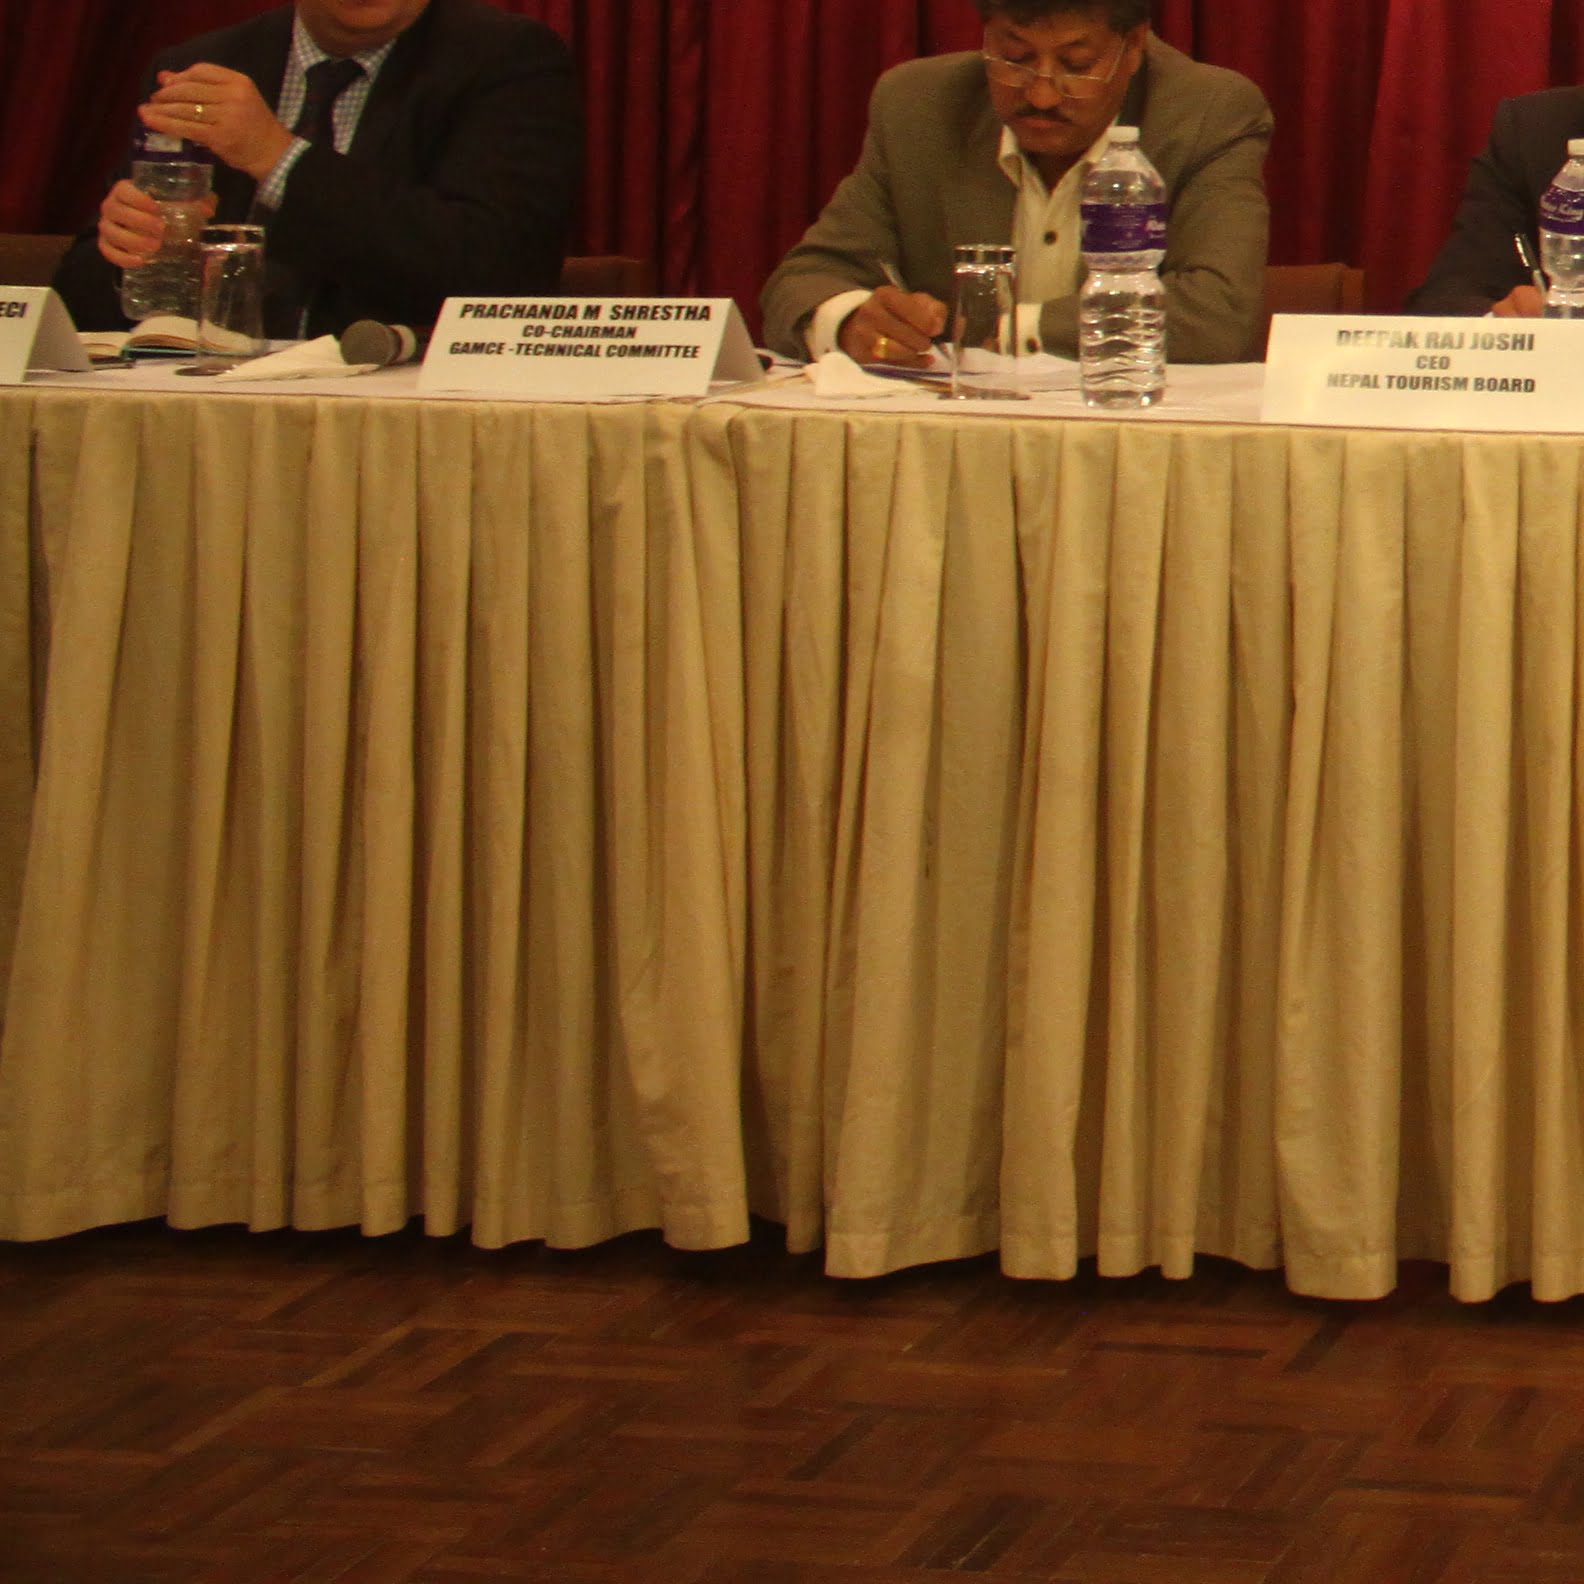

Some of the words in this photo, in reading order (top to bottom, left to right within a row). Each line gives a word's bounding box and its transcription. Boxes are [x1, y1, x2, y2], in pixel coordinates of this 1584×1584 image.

[460, 304, 578, 319] PRACHANDA
[583, 305, 602, 319] M
[610, 305, 711, 320] SHRESTHA
[523, 325, 637, 339] CO-CHAIRMAN
[1425, 331, 1464, 349] RAJ
[1470, 333, 1535, 351] JOSHI
[450, 342, 504, 355] GAMCE
[606, 345, 701, 358] COMMITTEE
[1416, 355, 1450, 369] CEO
[1327, 373, 1379, 388] NEPAL
[1386, 375, 1468, 391] TOURISM
[1474, 377, 1535, 392] BOARD
